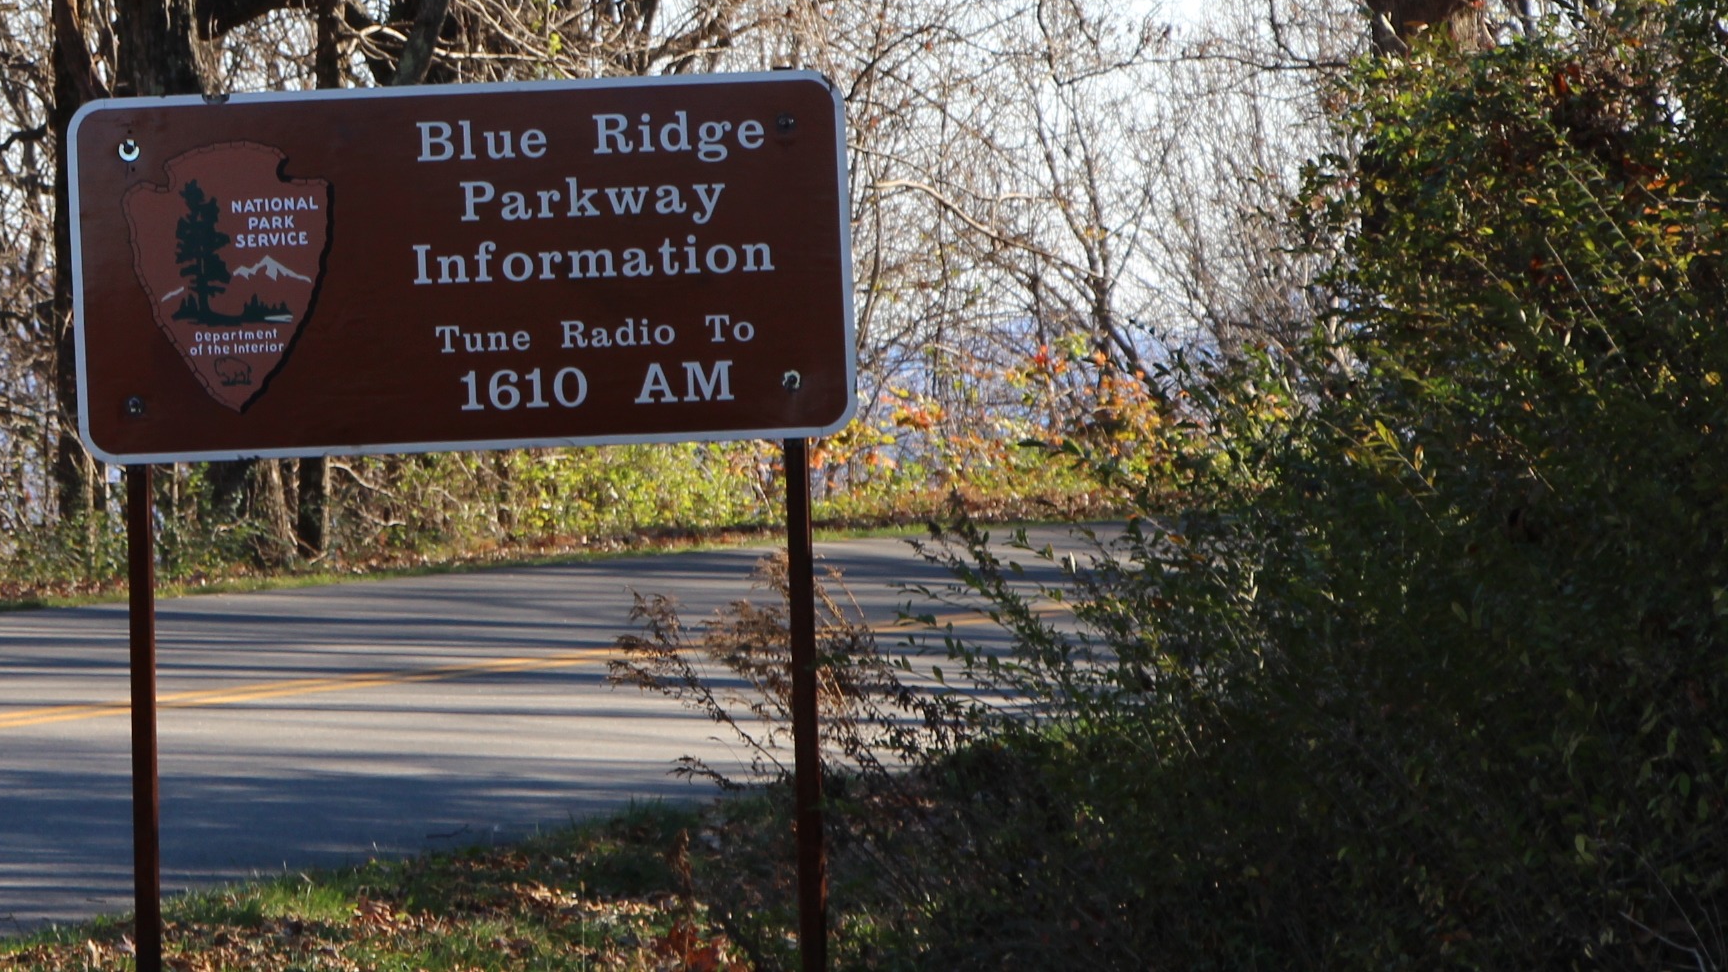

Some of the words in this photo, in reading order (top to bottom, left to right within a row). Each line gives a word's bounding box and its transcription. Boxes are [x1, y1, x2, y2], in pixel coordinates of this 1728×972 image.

[416, 121, 548, 163] Blue
[593, 110, 766, 163] Ridge
[232, 196, 318, 213] NATIONAL
[459, 177, 726, 224] Parkway
[248, 215, 294, 230] PARK
[235, 231, 308, 248] SERVICE
[413, 235, 776, 286] Information
[195, 328, 278, 343] Department
[435, 324, 531, 354] Tune
[561, 318, 676, 349] Radio
[705, 314, 756, 343] To
[190, 343, 203, 356] of
[208, 343, 229, 355] the
[234, 342, 284, 354] Interior
[459, 367, 588, 412] 1610
[634, 360, 735, 404] AM
